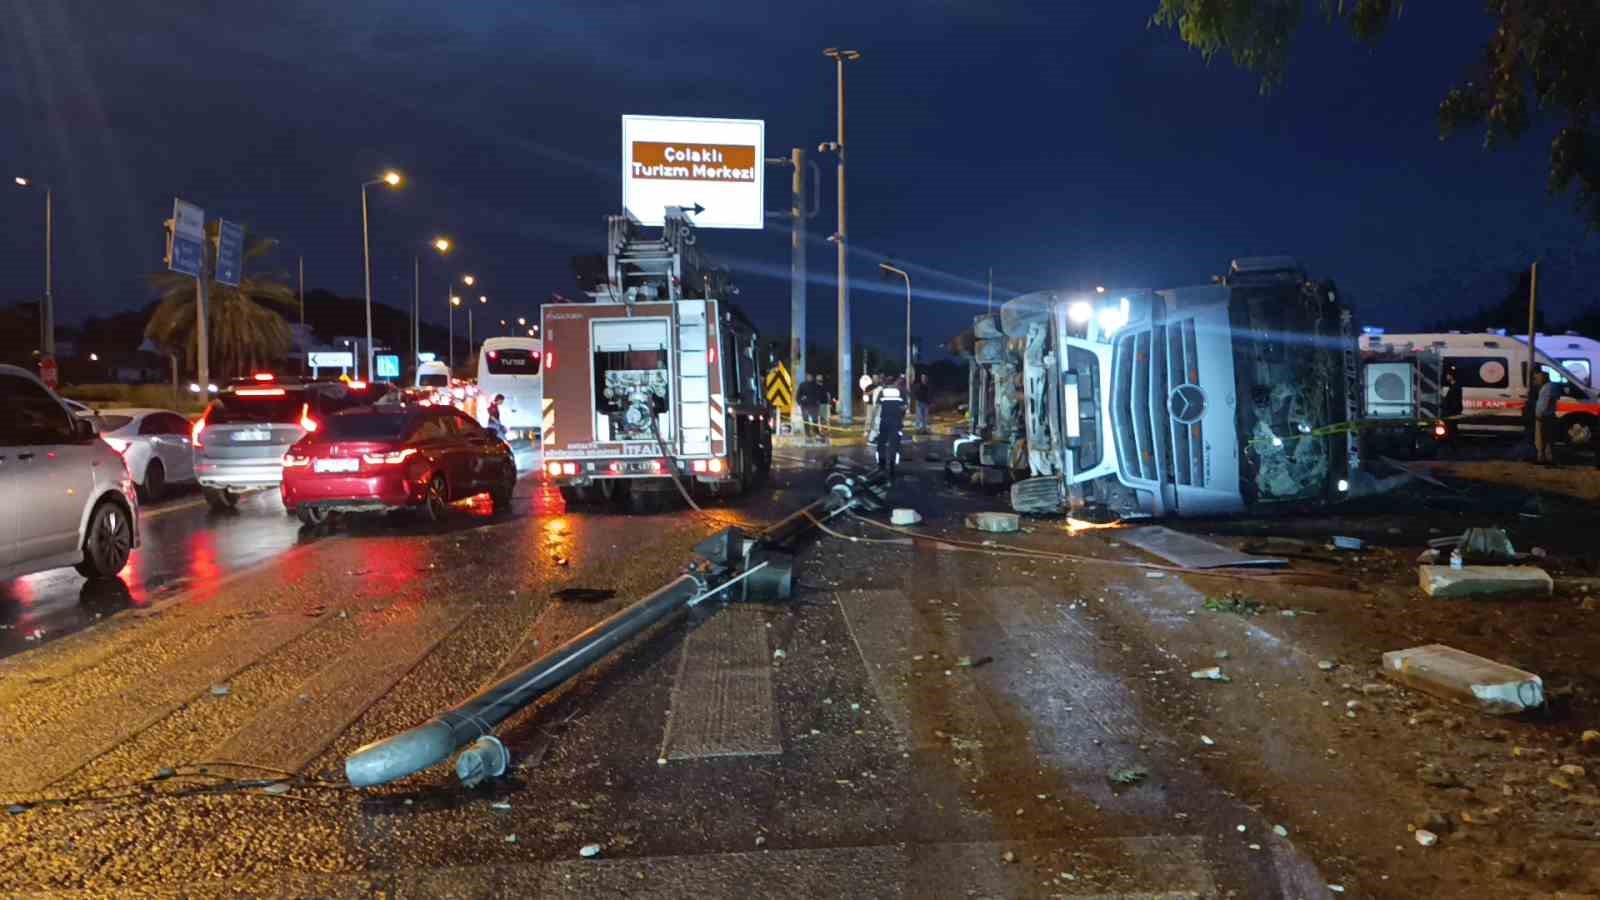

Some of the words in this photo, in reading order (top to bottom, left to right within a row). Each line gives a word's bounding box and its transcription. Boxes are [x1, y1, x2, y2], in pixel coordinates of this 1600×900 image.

[664, 146, 723, 162] Çolaklı
[632, 162, 689, 177] Turizm
[692, 164, 754, 180] Merkezi
